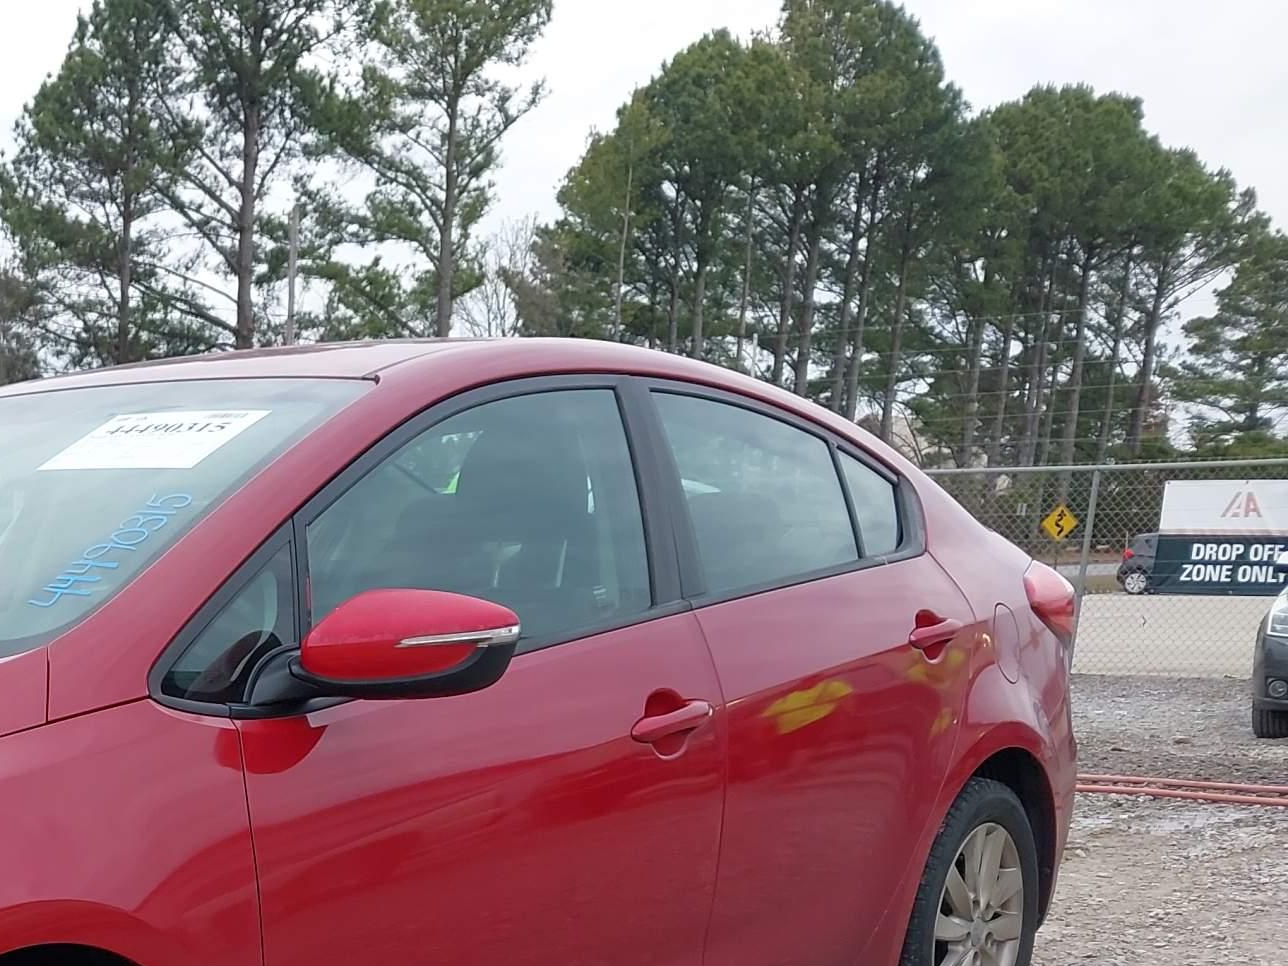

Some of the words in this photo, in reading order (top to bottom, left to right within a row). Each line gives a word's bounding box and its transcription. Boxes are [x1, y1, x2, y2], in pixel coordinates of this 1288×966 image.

[108, 421, 232, 435] 44490315
[28, 493, 193, 608] 44490315
[1191, 543, 1244, 561] DROP
[1180, 564, 1233, 583] ZONE
